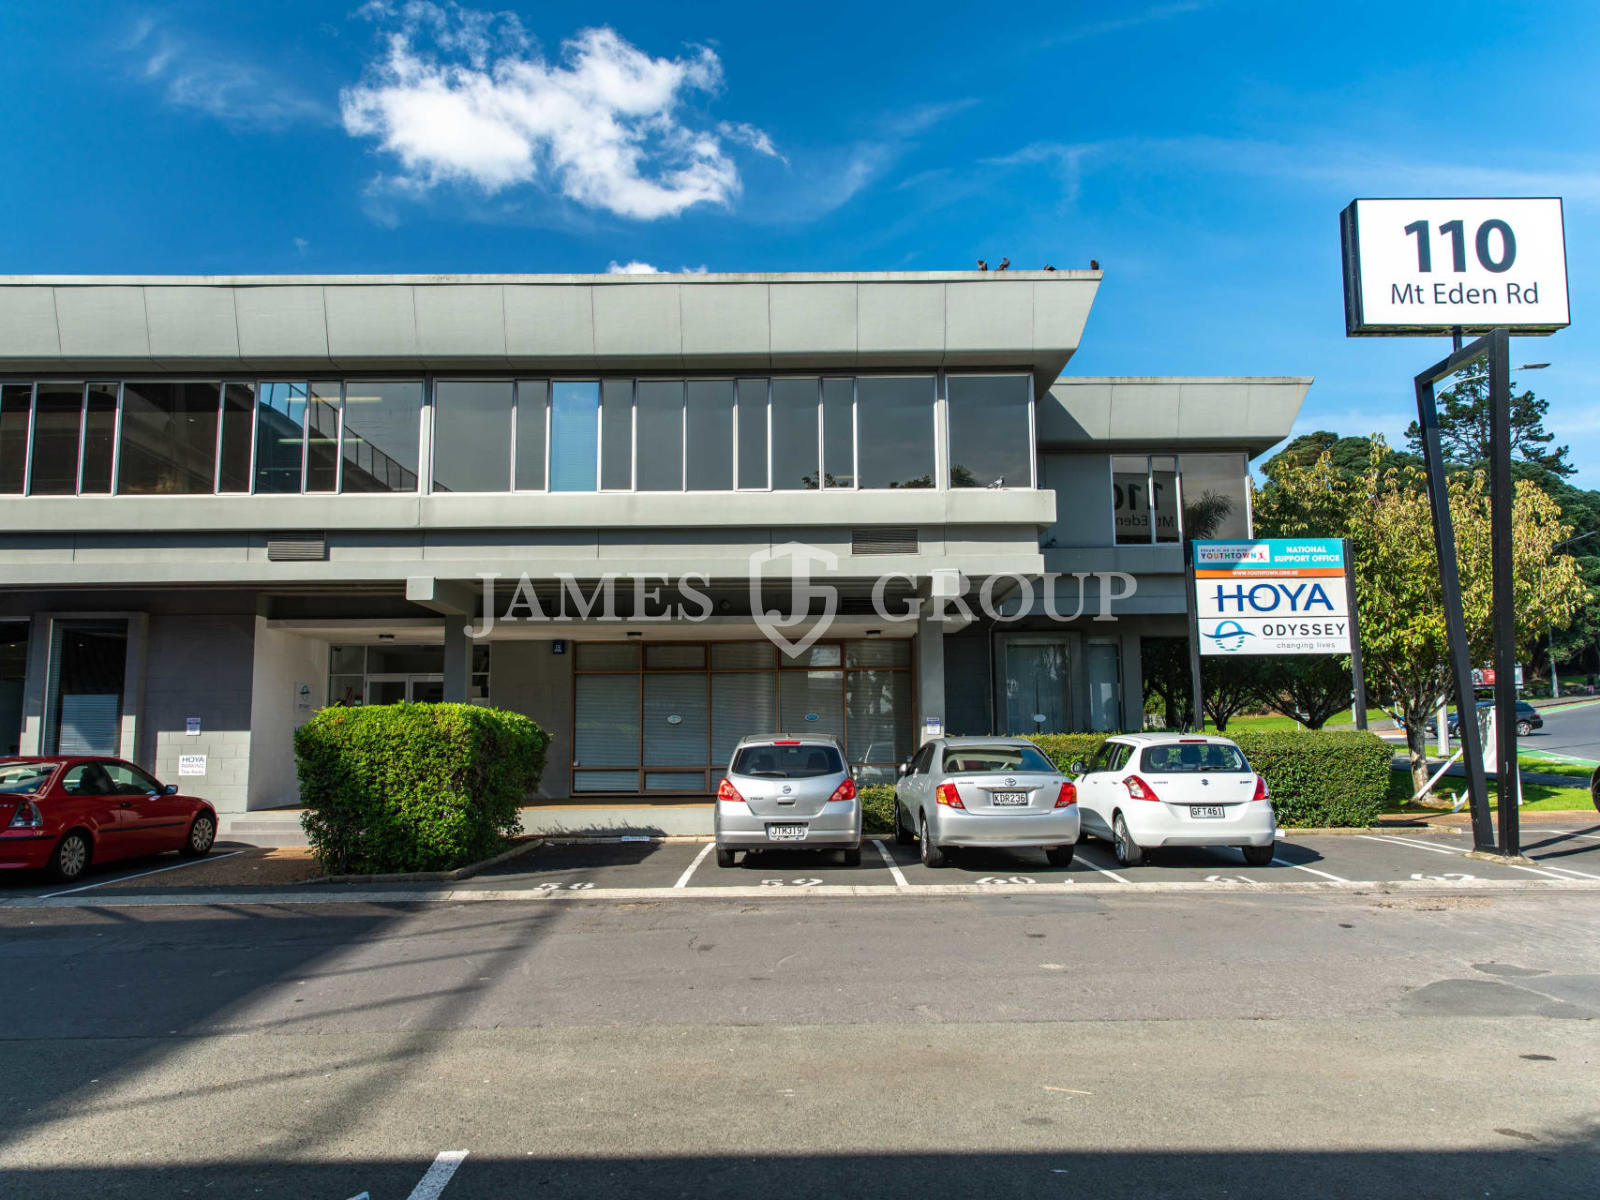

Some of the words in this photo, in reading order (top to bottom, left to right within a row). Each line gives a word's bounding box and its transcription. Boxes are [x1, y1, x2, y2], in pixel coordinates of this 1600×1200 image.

[1404, 219, 1516, 273] 110
[1391, 282, 1425, 305] Mt
[1433, 281, 1497, 305] Eden
[1506, 281, 1539, 304] Rd
[1200, 552, 1257, 560] YOUTHTOWN
[1311, 554, 1340, 562] OFFICE
[1210, 583, 1335, 612] HOYA
[1262, 623, 1345, 636] ODYSSEY
[1192, 807, 1222, 815] GFT461
